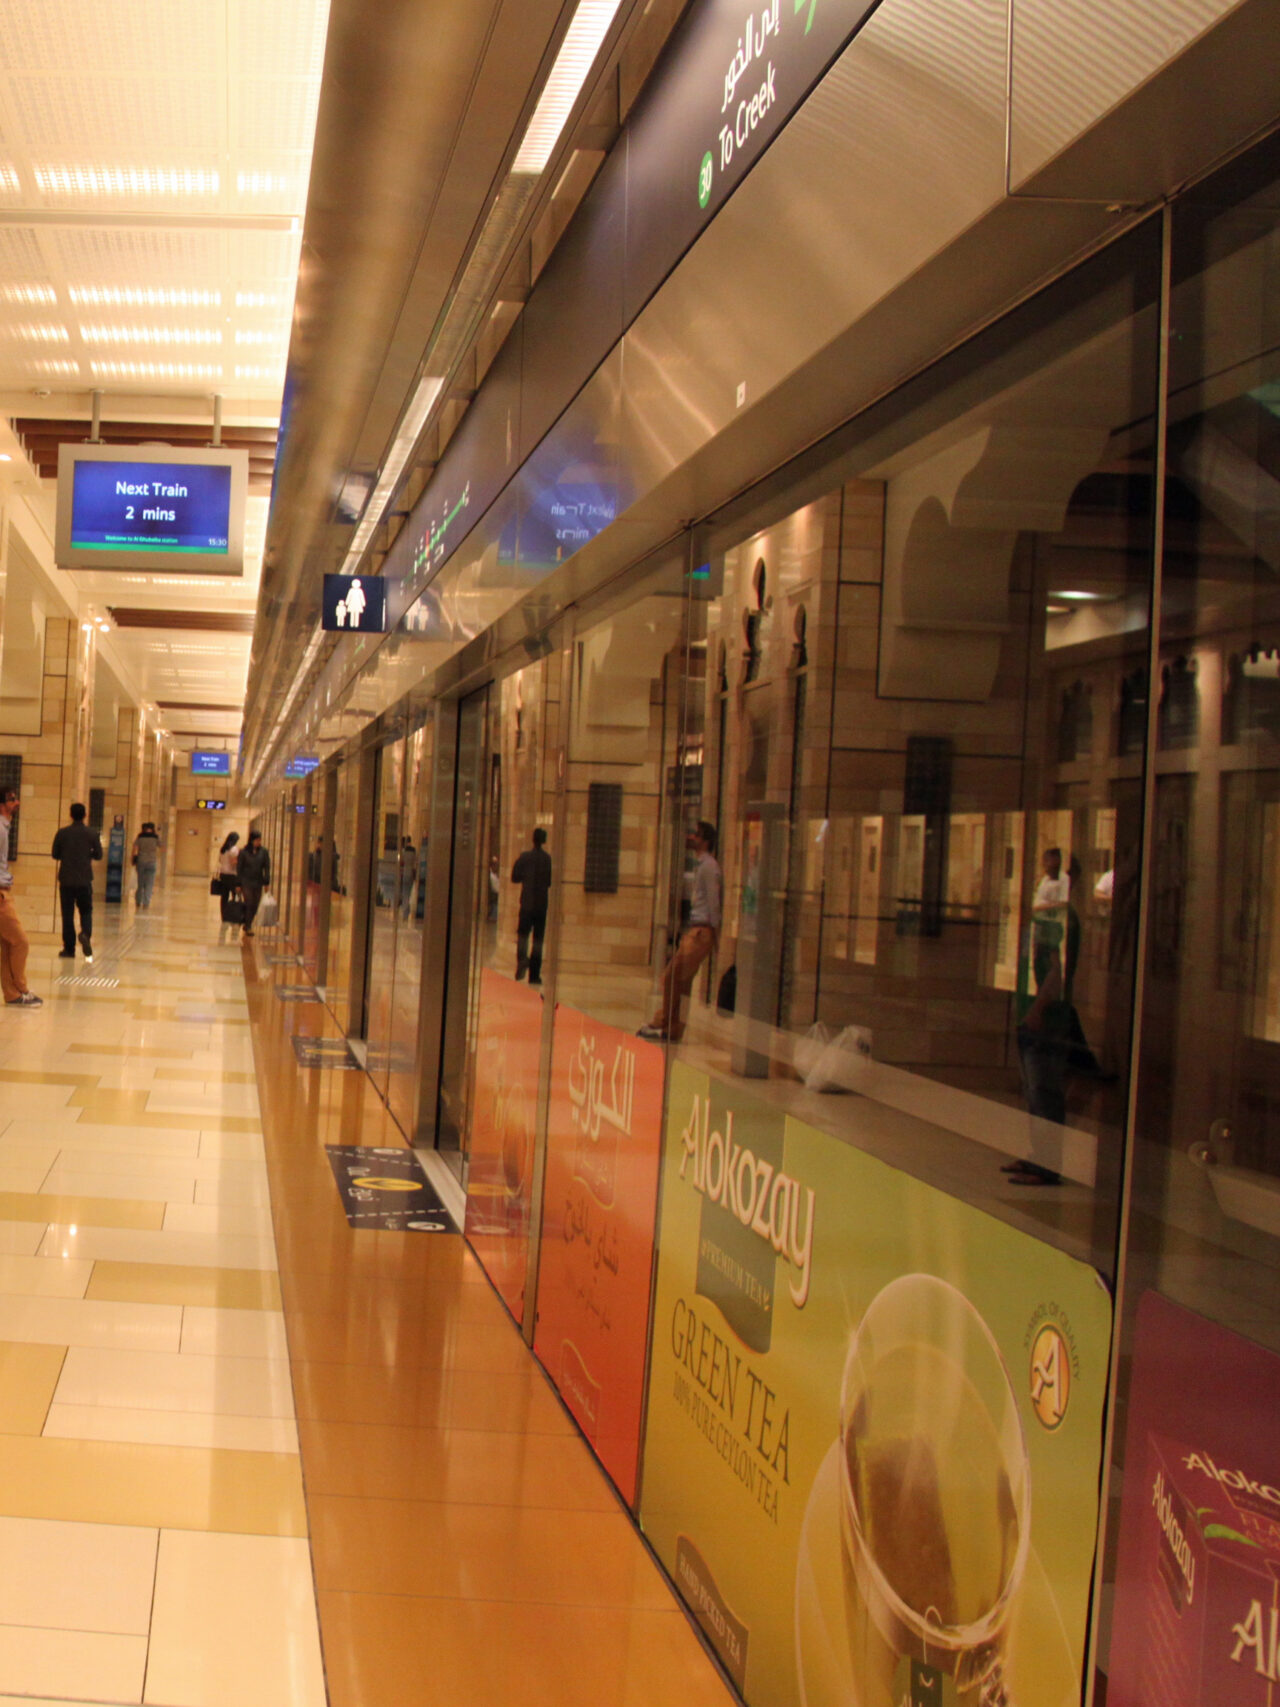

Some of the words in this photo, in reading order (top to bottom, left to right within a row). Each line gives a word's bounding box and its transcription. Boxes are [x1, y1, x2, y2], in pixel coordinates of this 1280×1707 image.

[700, 159, 713, 200] 30
[718, 124, 734, 172] To
[735, 60, 776, 149] Creek
[115, 481, 150, 496] Next
[152, 482, 188, 498] Train
[125, 506, 135, 520] 2
[142, 507, 176, 522] mins
[207, 538, 228, 547] 15:30
[679, 1093, 816, 1311] Alokozay
[671, 1298, 742, 1422] GREEN
[744, 1366, 791, 1488] TEA
[691, 1391, 717, 1445] PURE
[716, 1420, 757, 1494] CEYLON
[757, 1468, 779, 1526] TEA
[1151, 1471, 1196, 1606] Alokozay
